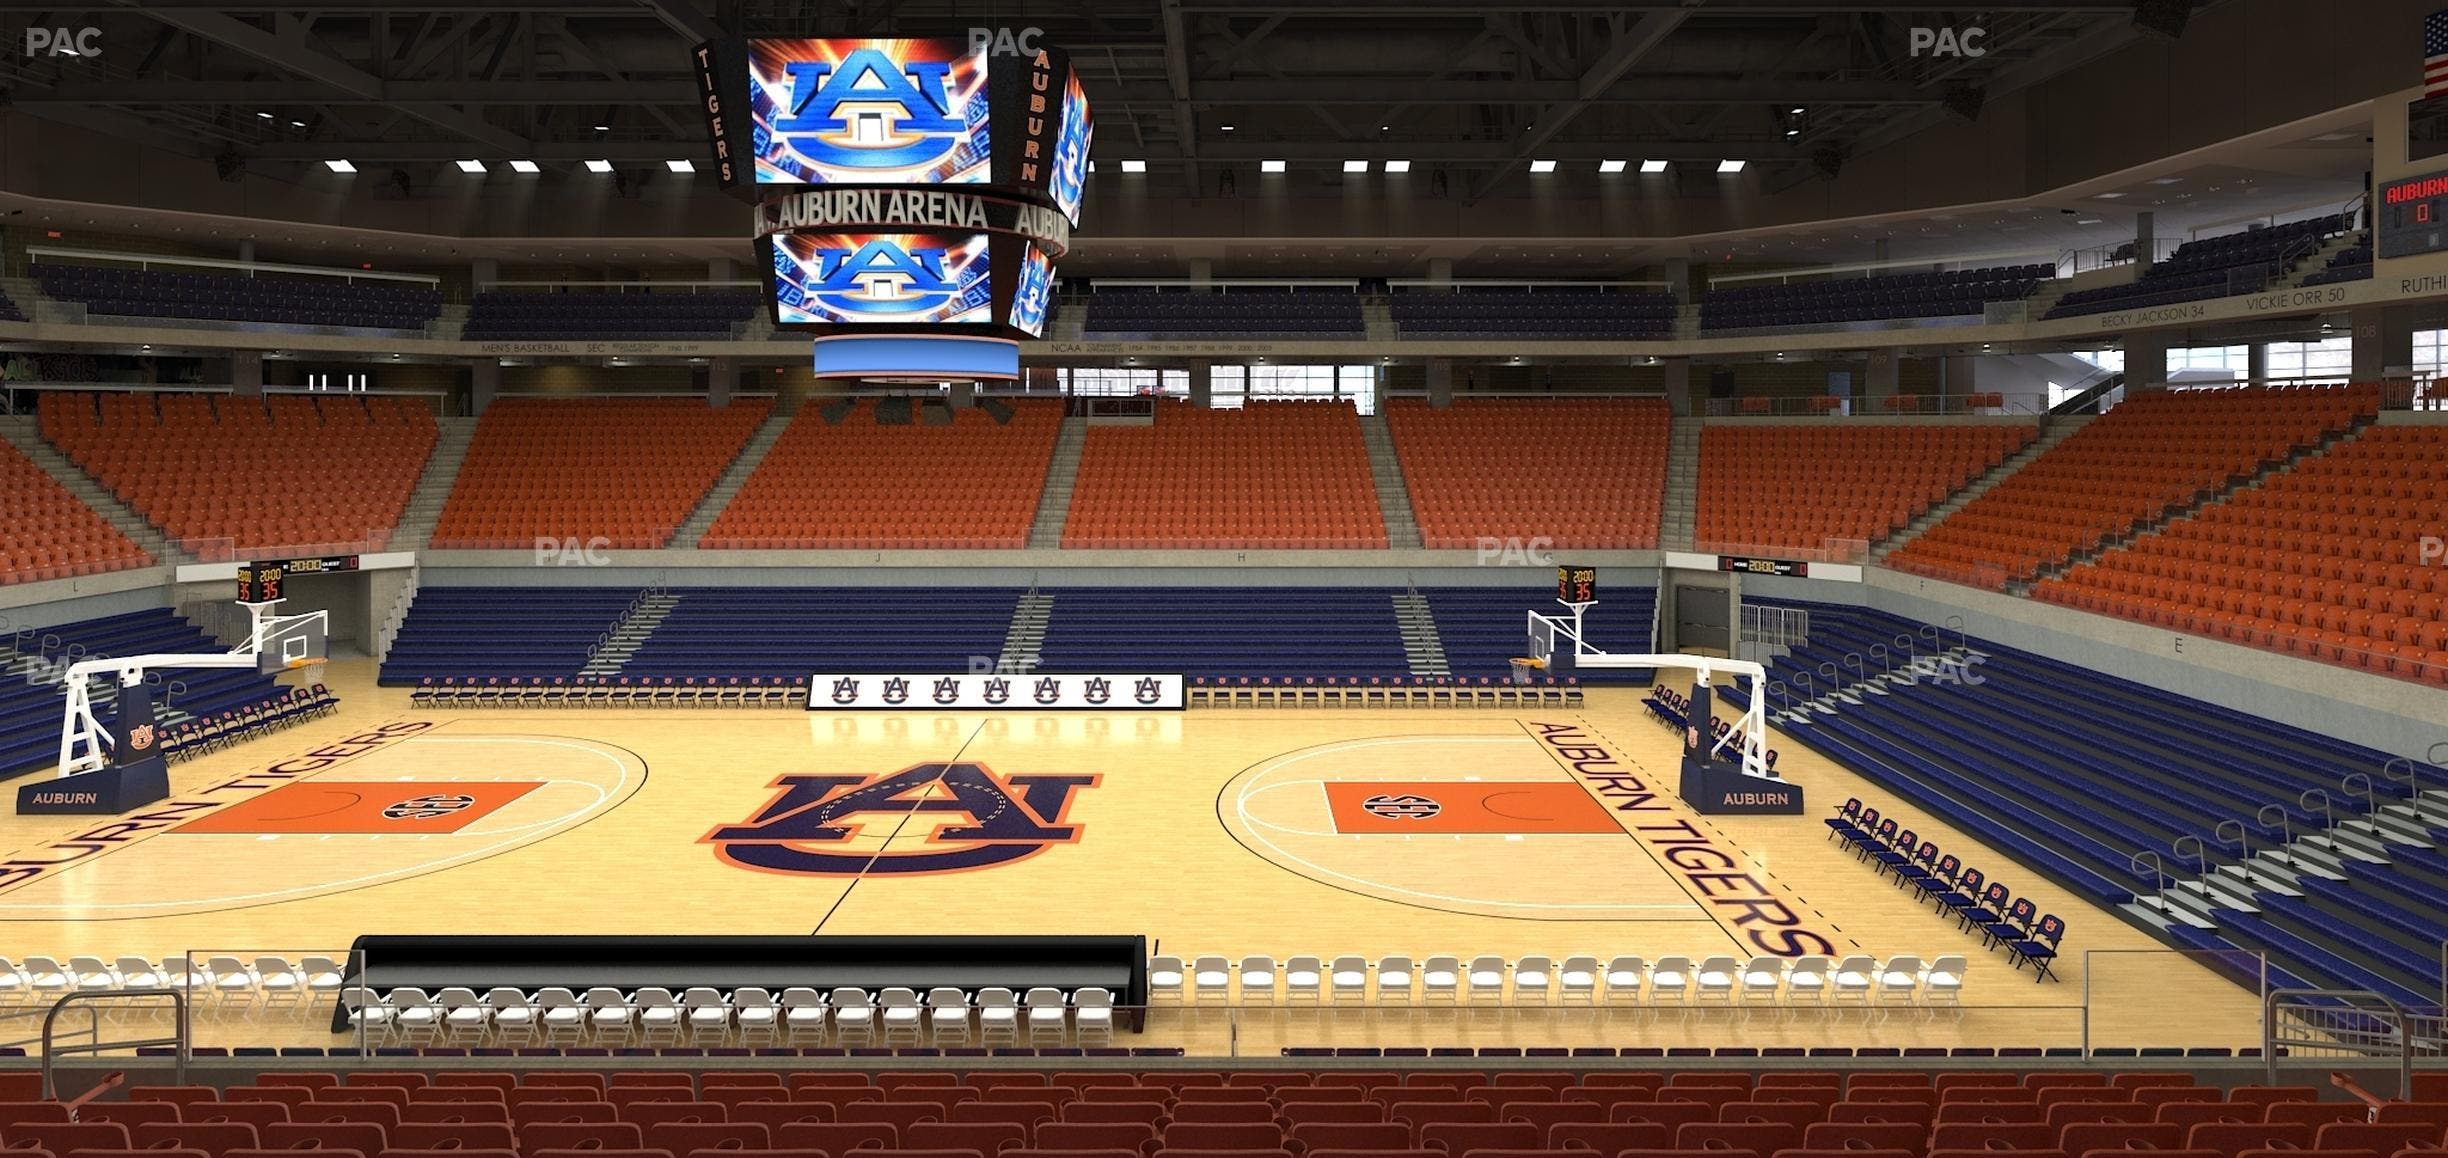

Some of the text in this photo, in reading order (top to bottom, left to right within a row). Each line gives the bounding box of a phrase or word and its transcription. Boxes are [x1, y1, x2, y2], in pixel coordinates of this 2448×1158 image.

[697, 47, 732, 183] TIGERS
[1021, 49, 1051, 182] AUBURN
[2386, 176, 2448, 205] AUBURN
[779, 190, 881, 230] AUBURN
[884, 190, 989, 228] ARENA
[2417, 204, 2429, 222] 0
[2246, 287, 2345, 310] VICKIE ORR 50
[2102, 305, 2204, 328] BECKY JACKSON 34
[513, 344, 570, 352] BASKETBALL
[586, 344, 606, 352] SEC
[1051, 344, 1081, 353] NCAA
[263, 581, 278, 600] 35
[1576, 582, 1591, 601] 35
[202, 719, 435, 796] TIGERS
[32, 792, 97, 804] AUBURN
[1723, 792, 1789, 805] AUBURN
[1529, 720, 1674, 812] AUBURN
[1634, 818, 1839, 959] TIGERS
